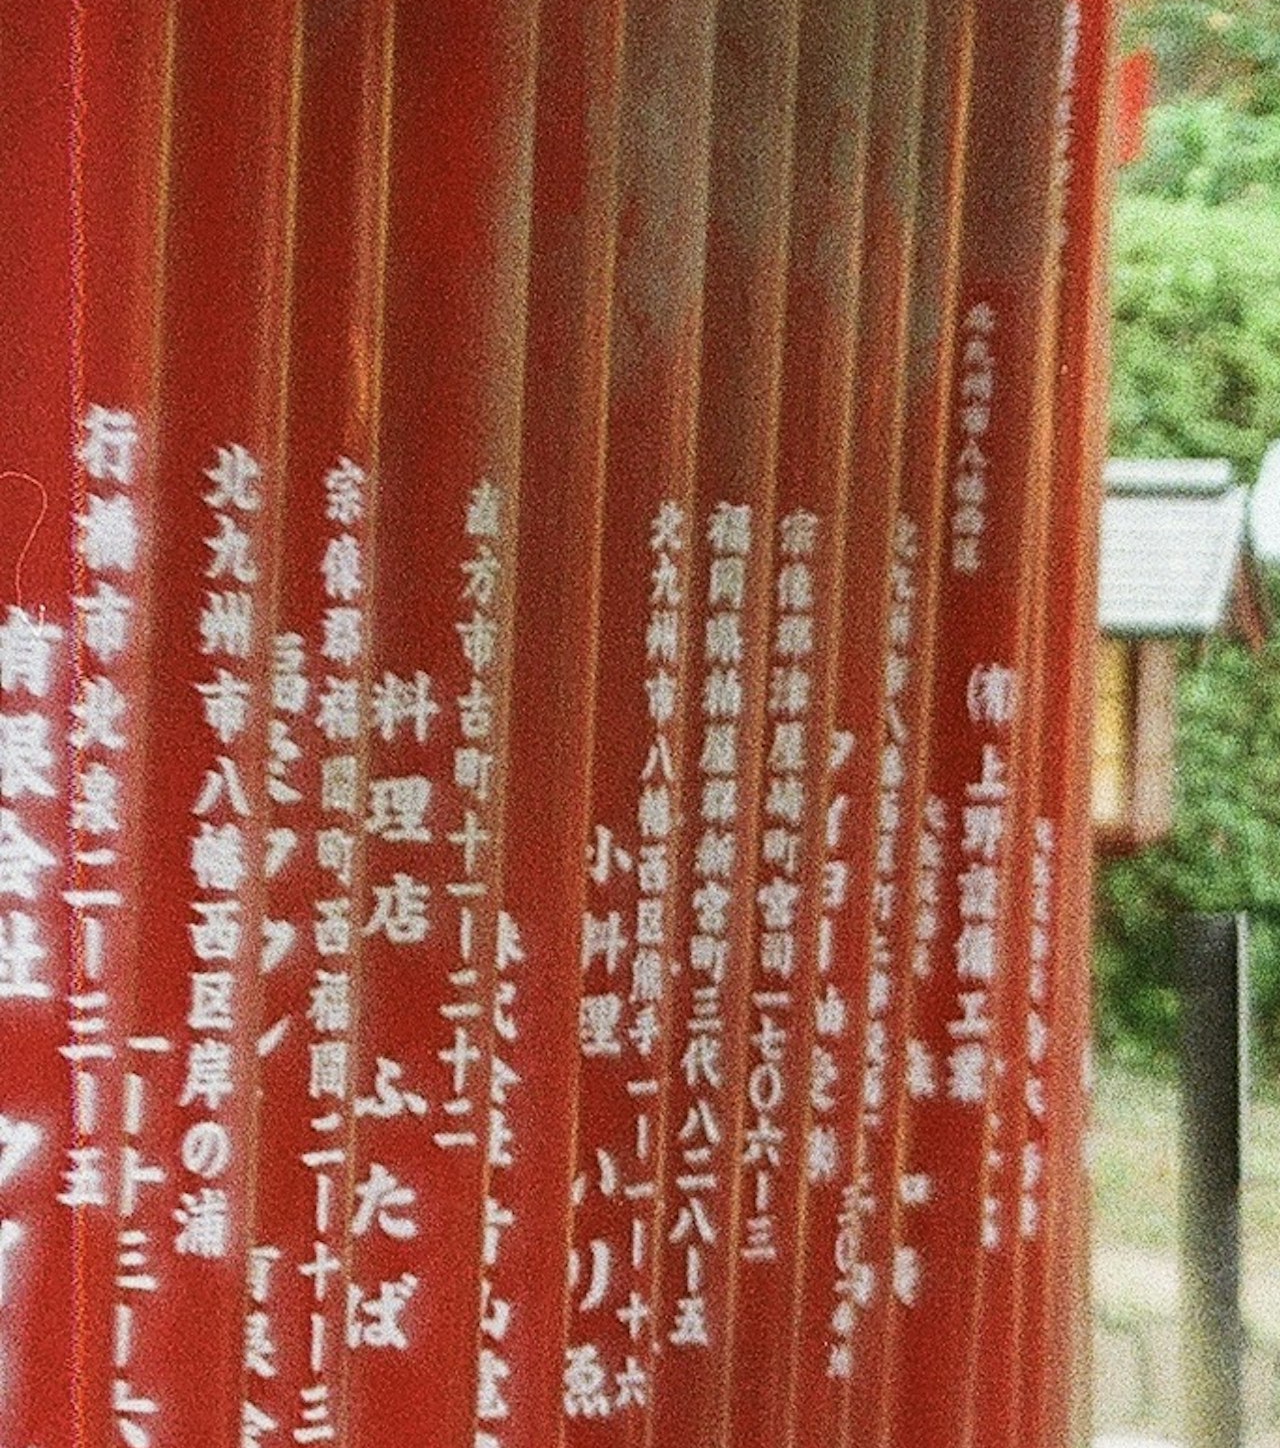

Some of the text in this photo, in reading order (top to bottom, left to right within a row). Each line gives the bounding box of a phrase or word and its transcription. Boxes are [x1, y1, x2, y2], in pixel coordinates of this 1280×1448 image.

[173, 442, 262, 1258] 北九州市八幡西区岸の浦
[346, 671, 440, 1350] 料理店 ふたば
